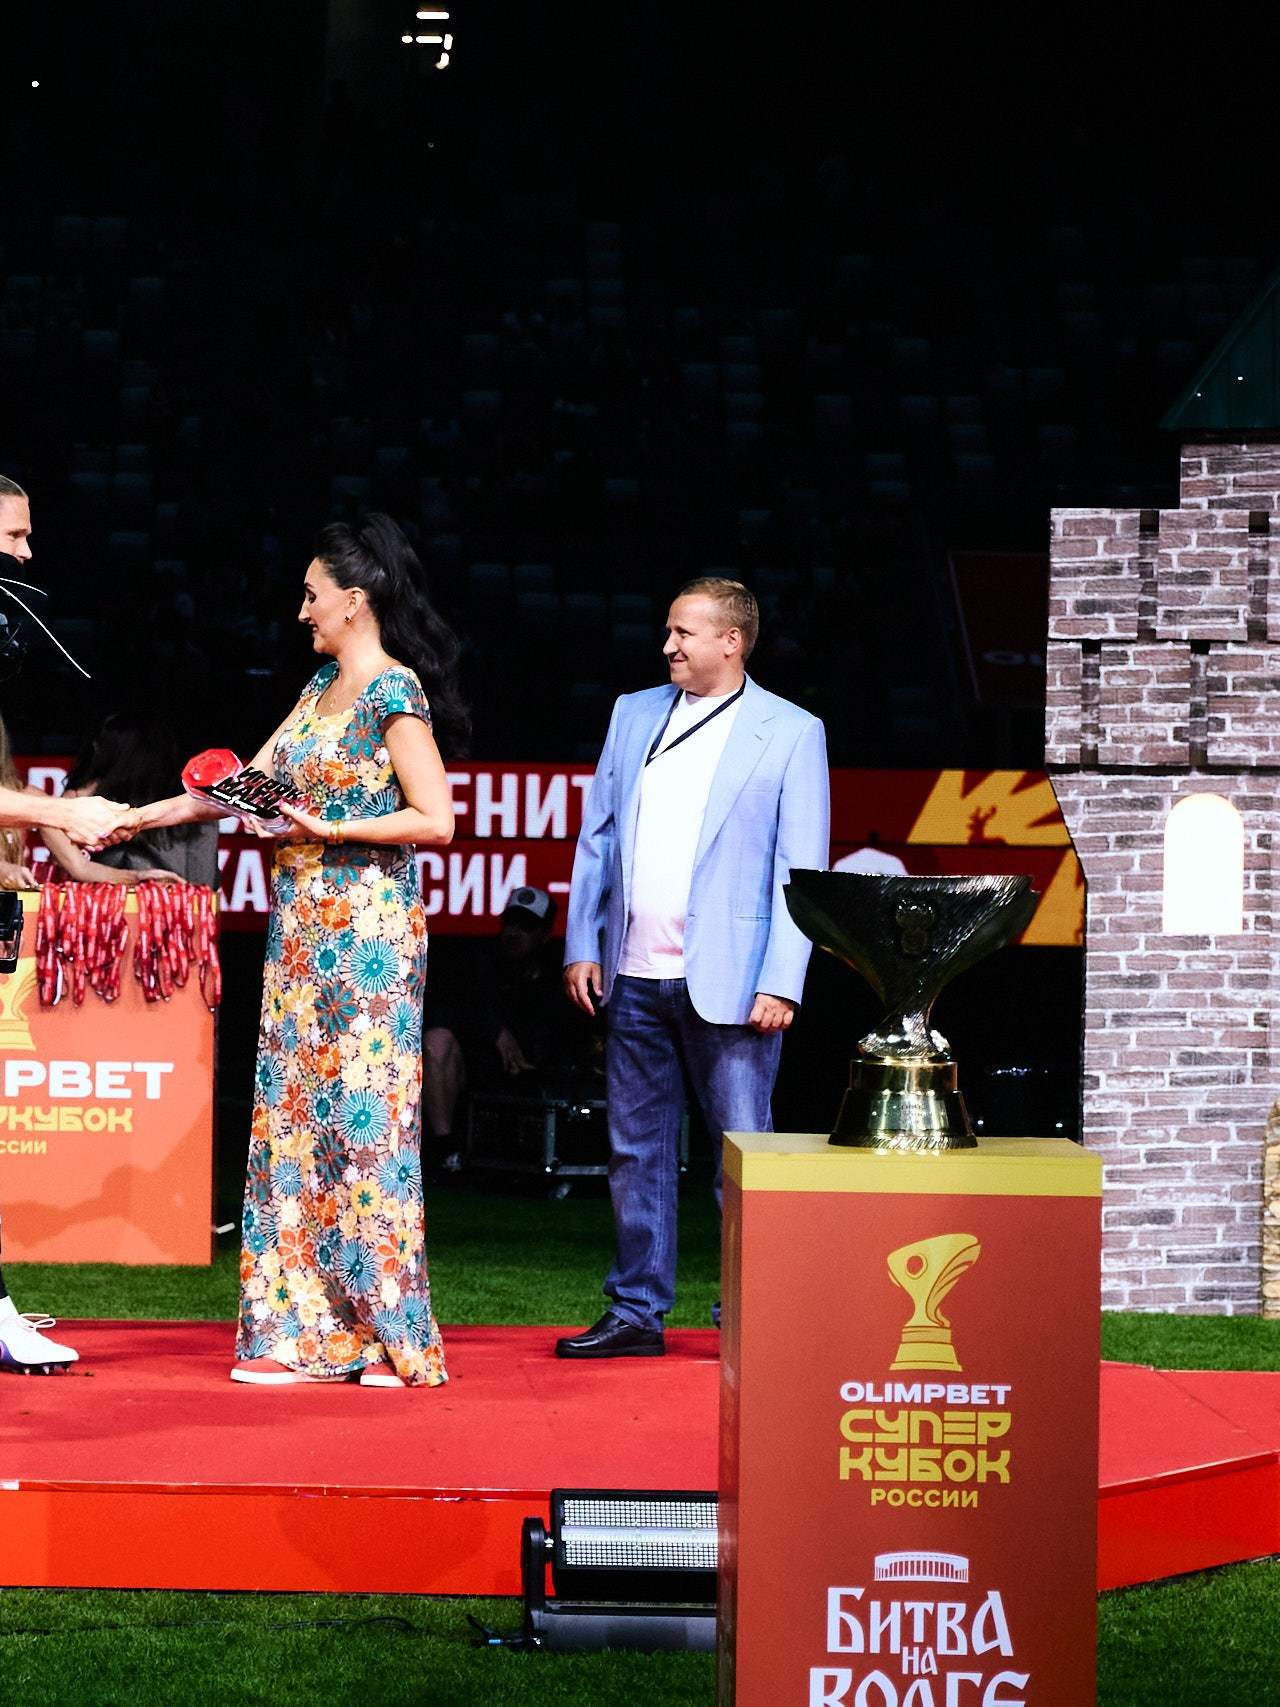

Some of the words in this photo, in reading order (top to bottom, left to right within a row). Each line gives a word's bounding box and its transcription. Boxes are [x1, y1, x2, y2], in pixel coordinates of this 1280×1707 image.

[839, 1382, 1012, 1405] OLIMPBET
[839, 1410, 1012, 1445] СУПЕР
[839, 1447, 1011, 1483] КУБОК
[870, 1488, 979, 1508] РОССИИ
[827, 1587, 1014, 1657] БИТВА
[902, 1646, 938, 1675] НА
